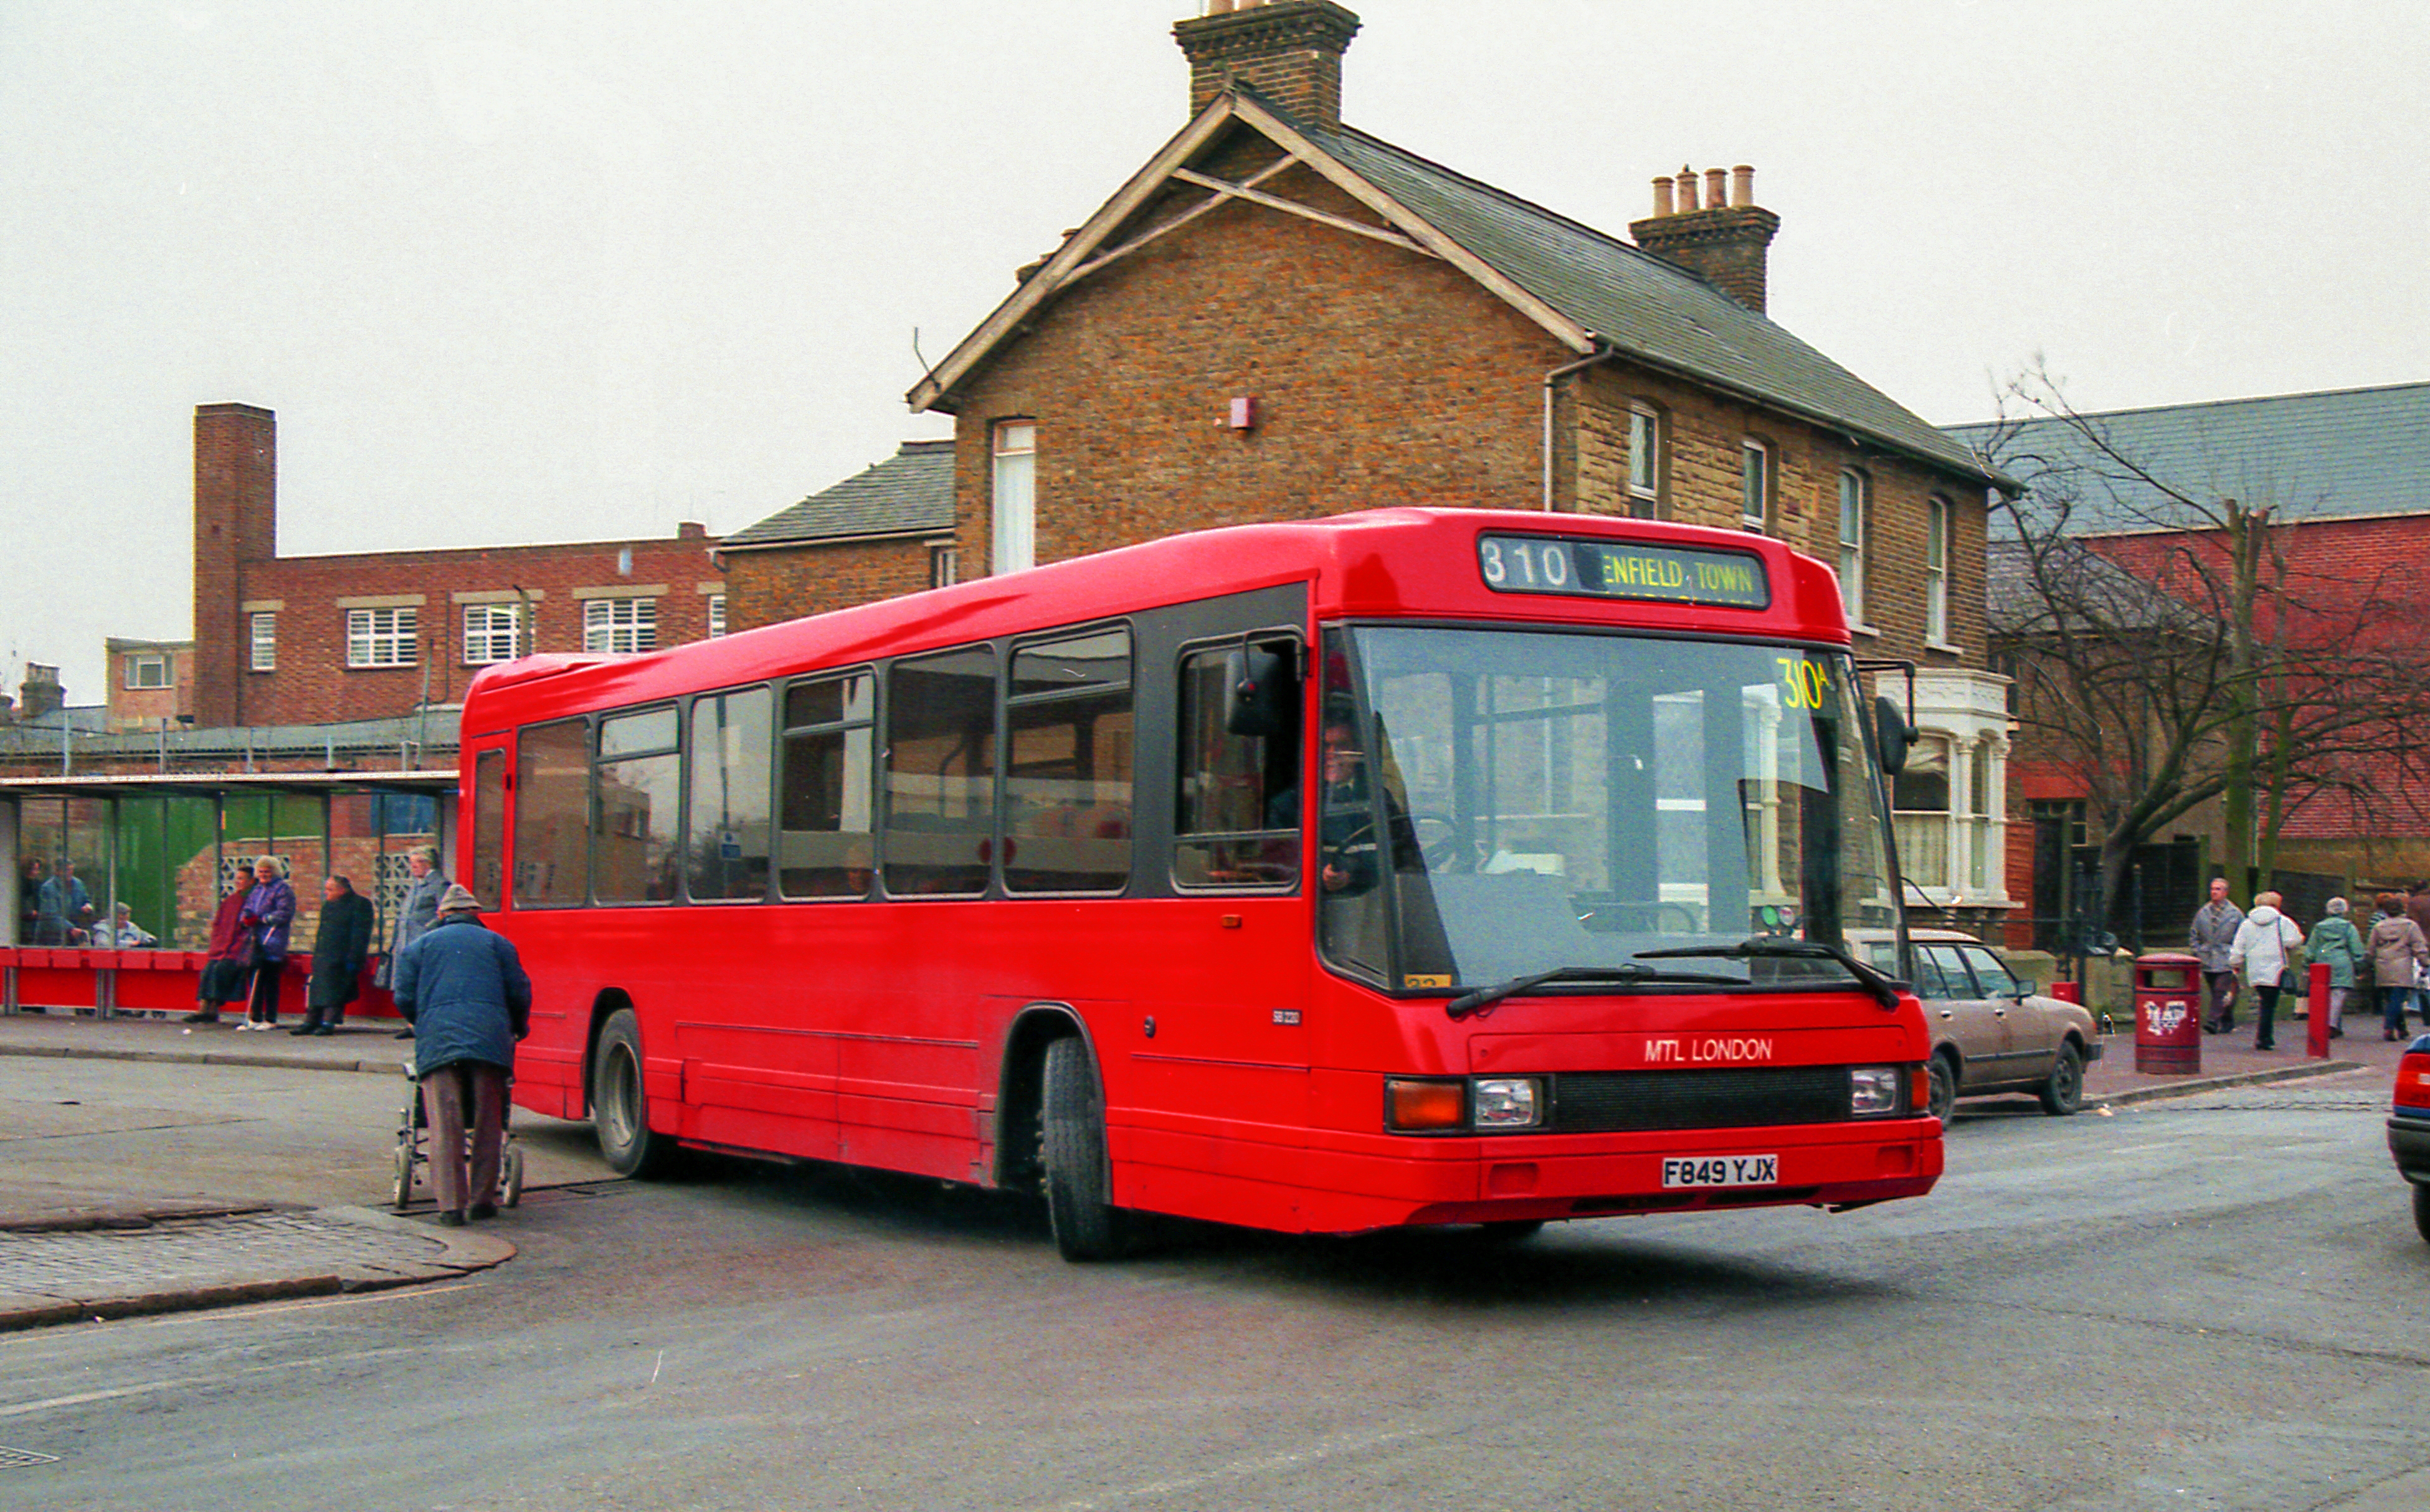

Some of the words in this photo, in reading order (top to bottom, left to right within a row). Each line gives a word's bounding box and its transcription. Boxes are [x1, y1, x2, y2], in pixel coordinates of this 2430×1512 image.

[1480, 540, 1569, 587] 310
[1603, 555, 1682, 588] ENFIELD
[1693, 562, 1755, 593] TOWN
[1645, 1039, 1686, 1062] MTL
[1691, 1037, 1773, 1061] LONDON
[1664, 1160, 1727, 1184] F849
[1732, 1158, 1777, 1183] YJX
